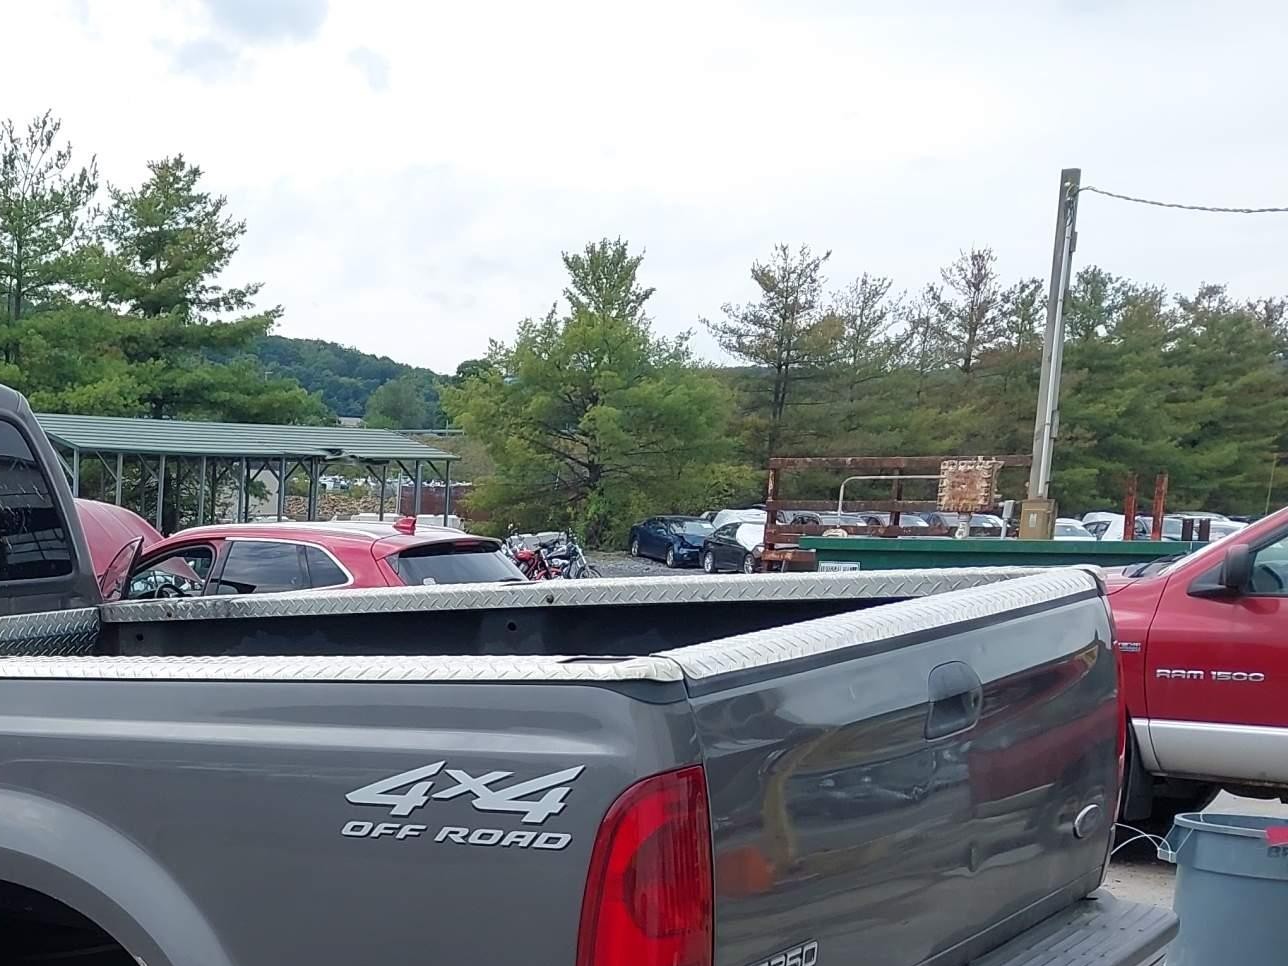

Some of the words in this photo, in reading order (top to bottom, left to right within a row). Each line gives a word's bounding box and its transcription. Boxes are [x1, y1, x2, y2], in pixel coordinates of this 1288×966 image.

[1156, 669, 1204, 680] RAM
[1210, 671, 1265, 682] 1500
[341, 820, 427, 840] OFF
[434, 826, 572, 850] ROAD
